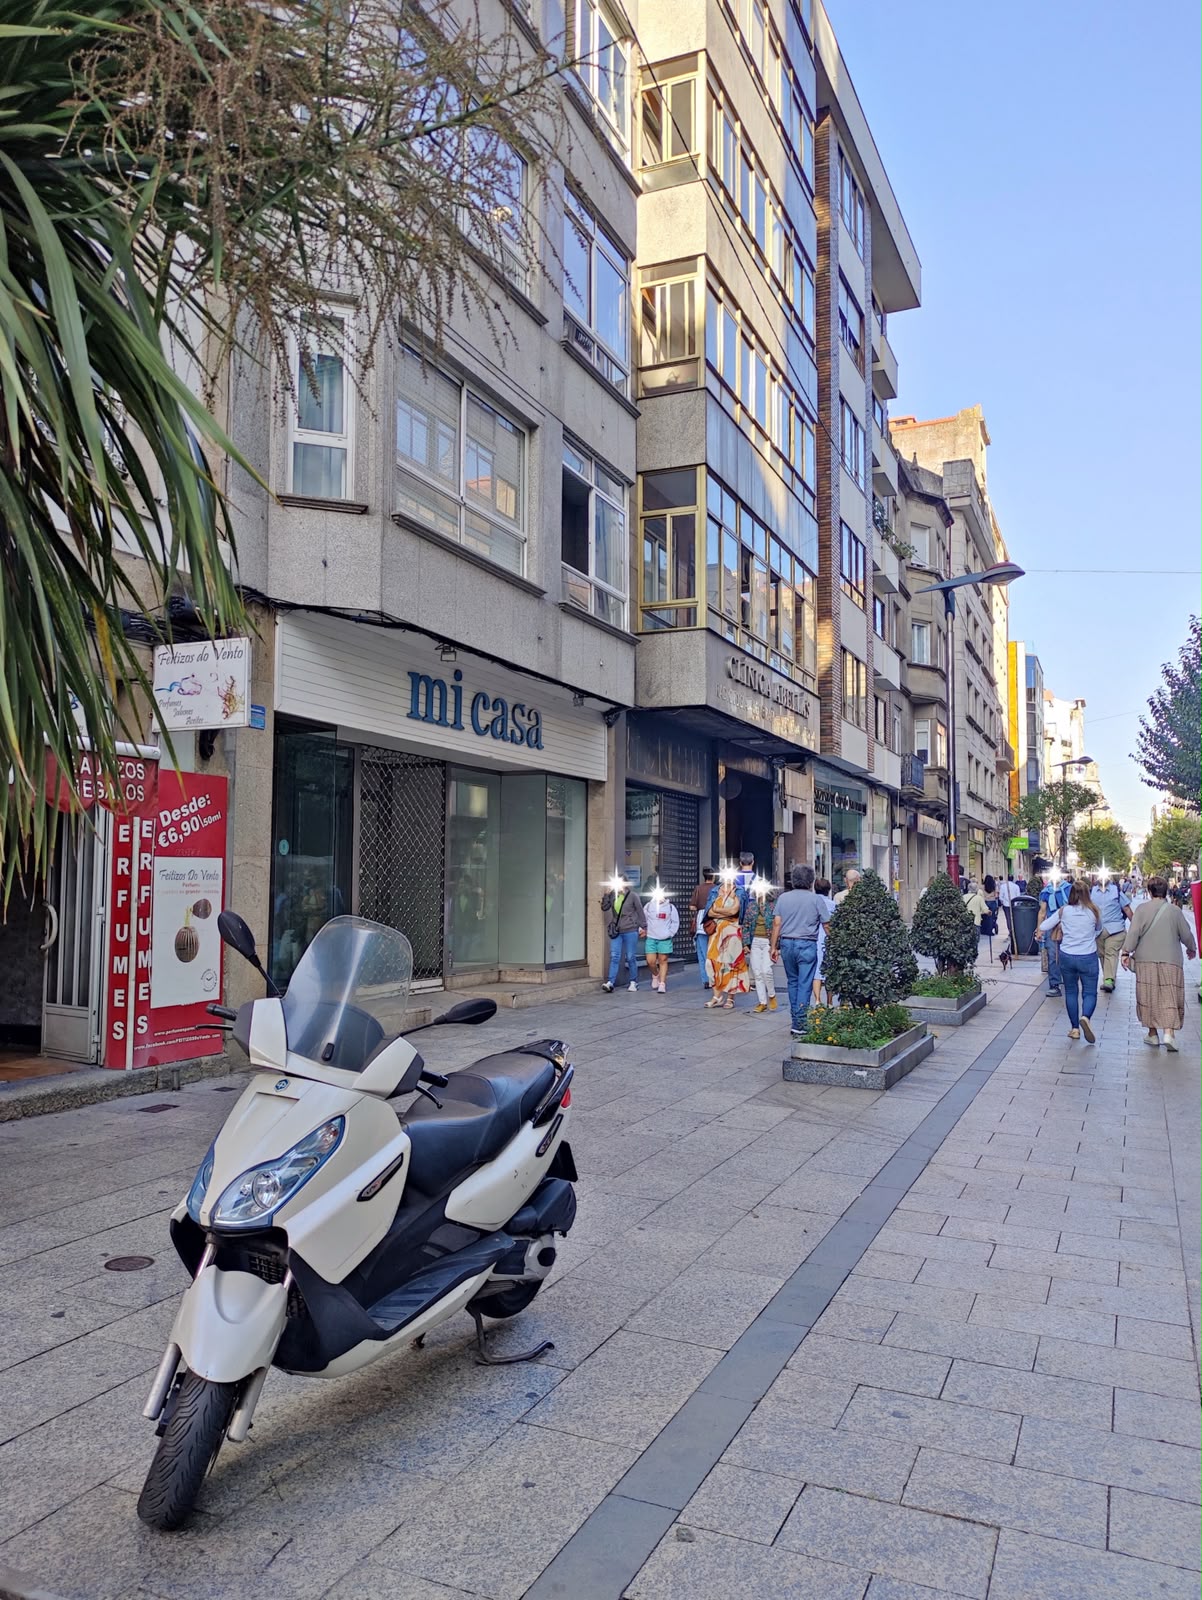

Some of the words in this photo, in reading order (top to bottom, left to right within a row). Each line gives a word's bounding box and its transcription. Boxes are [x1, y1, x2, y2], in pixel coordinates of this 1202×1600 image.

[196, 645, 209, 662] do
[215, 646, 244, 661] Vento
[406, 668, 465, 731] mi
[470, 691, 545, 751] casa
[159, 793, 212, 828] Desde:
[200, 869, 220, 881] Vento
[112, 824, 131, 1041] ERFUMES
[136, 820, 153, 1035] ERFUMES
